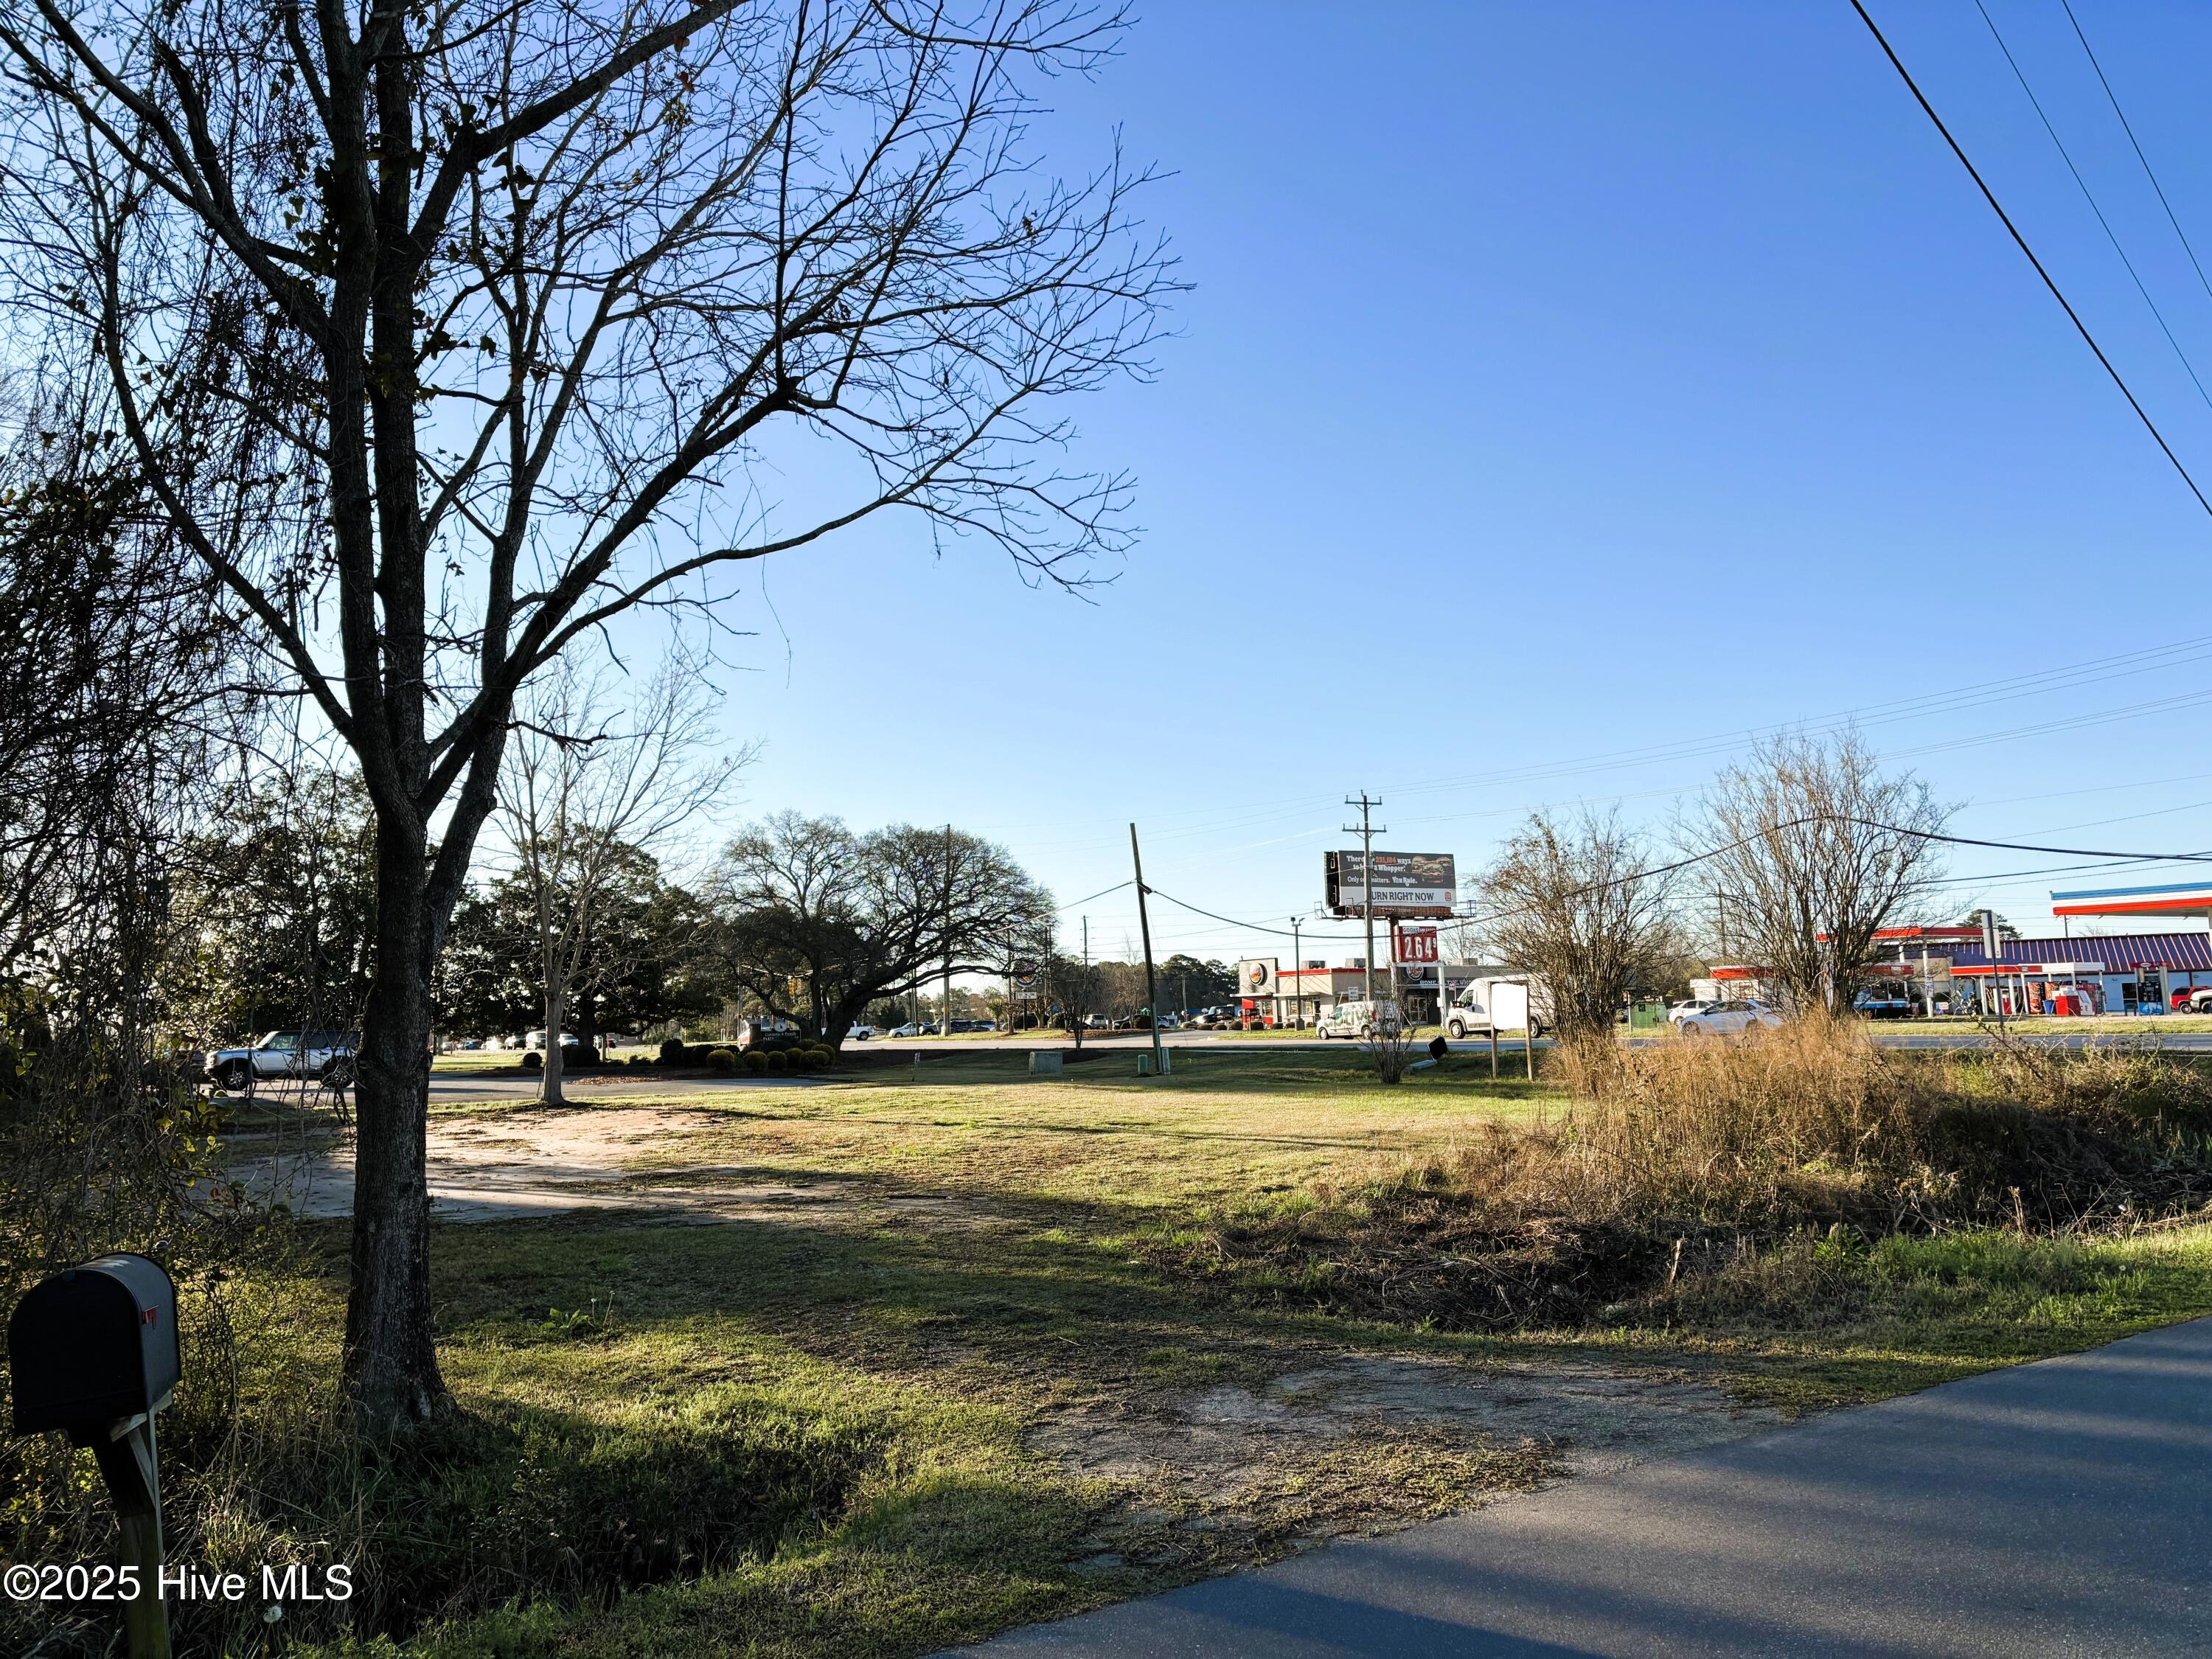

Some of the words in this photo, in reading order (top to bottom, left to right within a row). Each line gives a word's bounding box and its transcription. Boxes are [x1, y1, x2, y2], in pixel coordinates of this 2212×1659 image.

[1371, 891, 1388, 900] URN
[1390, 891, 1413, 901] RIGHT
[1415, 892, 1434, 901] NOW
